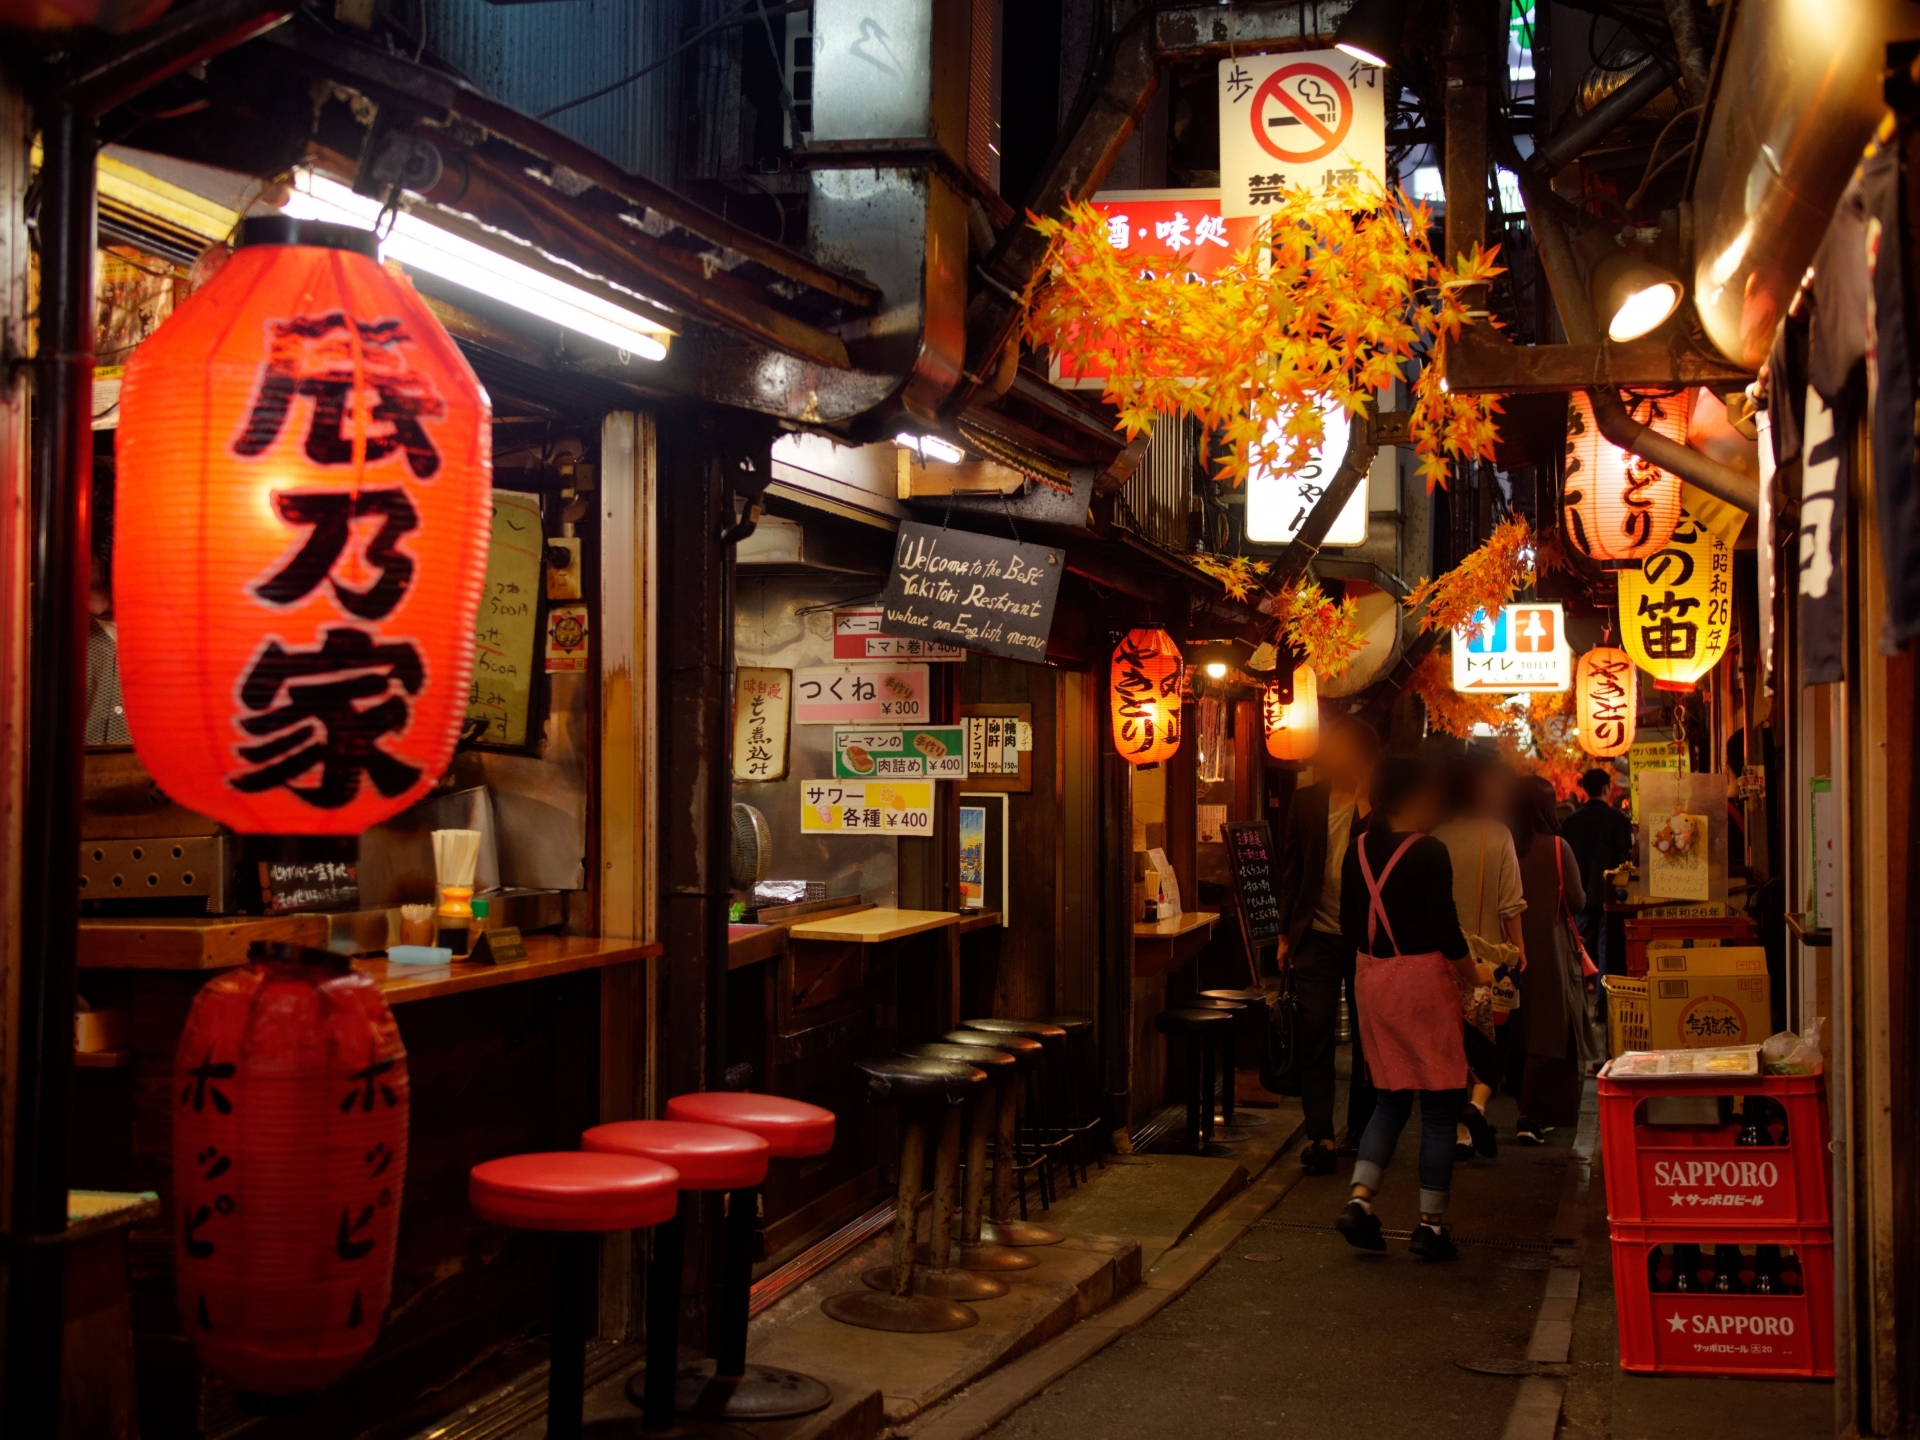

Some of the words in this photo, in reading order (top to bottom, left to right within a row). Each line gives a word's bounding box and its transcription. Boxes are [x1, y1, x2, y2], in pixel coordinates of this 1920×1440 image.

[897, 533, 970, 576] Welcome
[968, 559, 982, 577] to
[982, 558, 1002, 579] the
[1002, 554, 1044, 586] Best
[932, 618, 950, 632] an
[950, 612, 1004, 642] English
[866, 640, 922, 655] トマト巻
[1467, 656, 1515, 672] トイレ
[1521, 660, 1558, 670] TOILET
[743, 677, 783, 701] 味自慢
[799, 676, 877, 702] つくね
[884, 675, 915, 700] 手作り
[1114, 636, 1161, 756] やきとり
[881, 700, 920, 716] ¥300
[1587, 659, 1630, 750] やきとり
[745, 694, 773, 776] もつ煮込み
[838, 734, 902, 749] ピーマンの
[914, 735, 946, 757] 手作り
[973, 722, 983, 760] ナンコツ
[988, 722, 1001, 748] 砂肝
[1004, 722, 1017, 748] 精肉
[877, 758, 921, 774] 肉詰め
[928, 758, 961, 771] ¥400
[806, 786, 865, 805] サワー
[843, 807, 882, 828] 各種
[886, 812, 928, 828] ¥400
[1685, 1012, 1741, 1037] 烏龍茶
[1654, 1160, 1779, 1188] SAPPORO
[1685, 1193, 1765, 1207] サッポロビール
[1691, 1314, 1795, 1336] SAPPORO
[1692, 1342, 1749, 1354] サッポロビール
